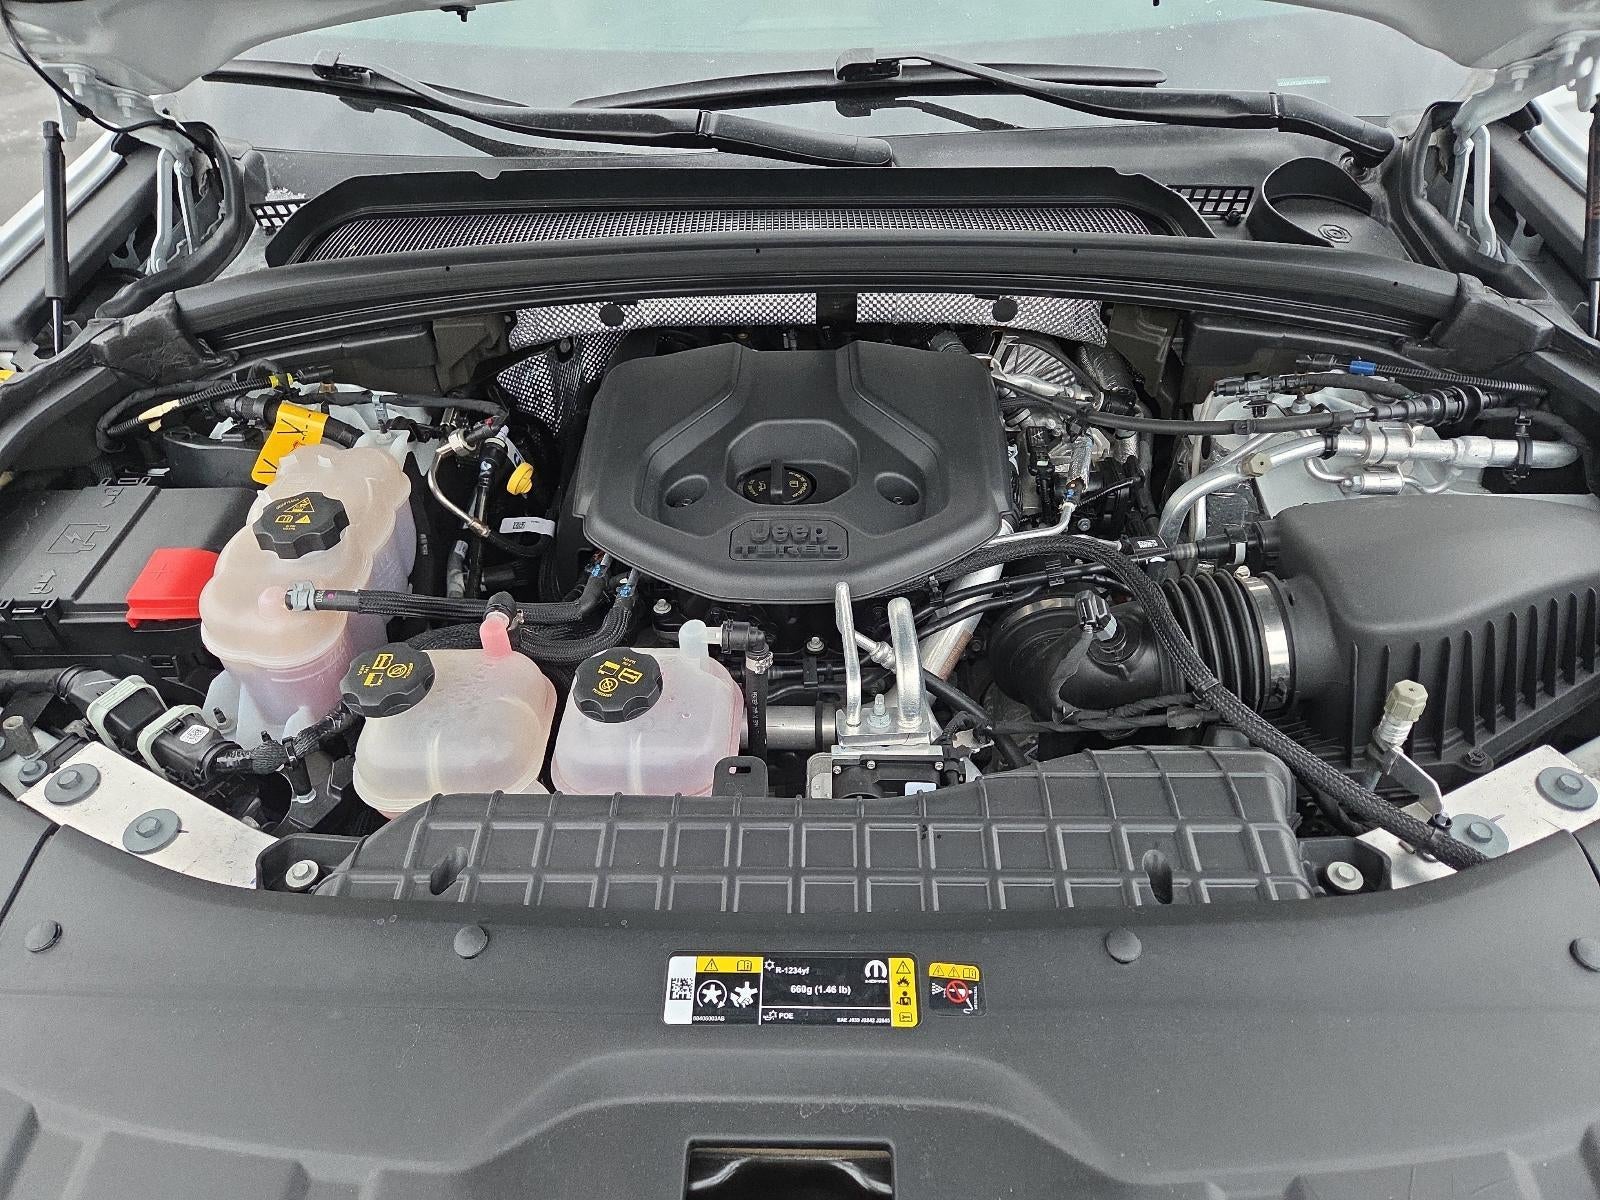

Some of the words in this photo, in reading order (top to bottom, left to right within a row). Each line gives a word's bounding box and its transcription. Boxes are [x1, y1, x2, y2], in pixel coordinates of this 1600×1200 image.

[750, 521, 828, 545] Jeep
[775, 966, 810, 976] R-1234yf
[790, 984, 813, 996] 660g
[814, 984, 837, 996] (1.46
[838, 984, 852, 996] lb)
[778, 1012, 795, 1020] POE
